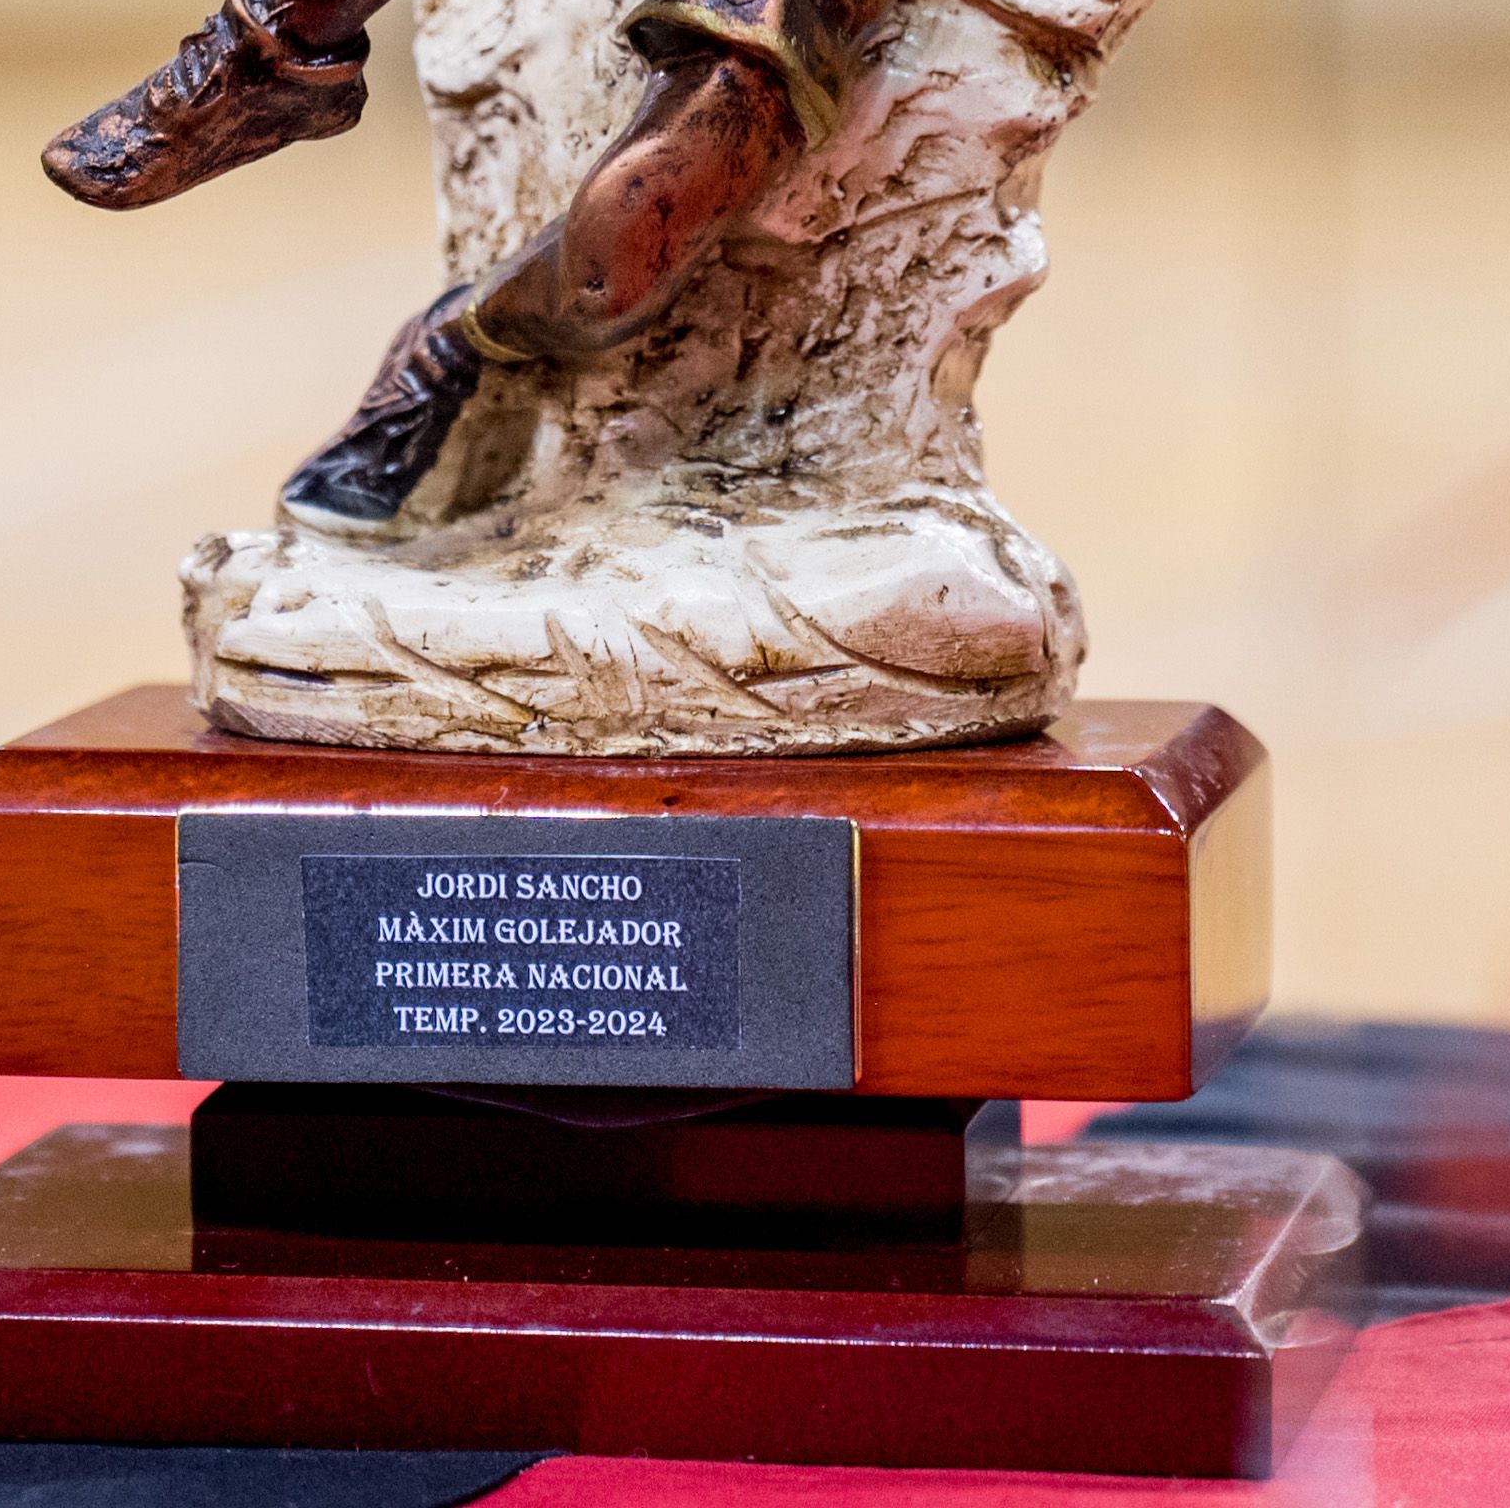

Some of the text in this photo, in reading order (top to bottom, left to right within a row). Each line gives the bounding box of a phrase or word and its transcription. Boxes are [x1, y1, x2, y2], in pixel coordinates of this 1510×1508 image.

[417, 872, 643, 902] JORDI SANCHO
[377, 910, 682, 949] MÀXIM GOLEJADOR
[374, 961, 689, 992] PRIMERA NACIONAL
[393, 1006, 668, 1037] TEMP. 2023-2024
